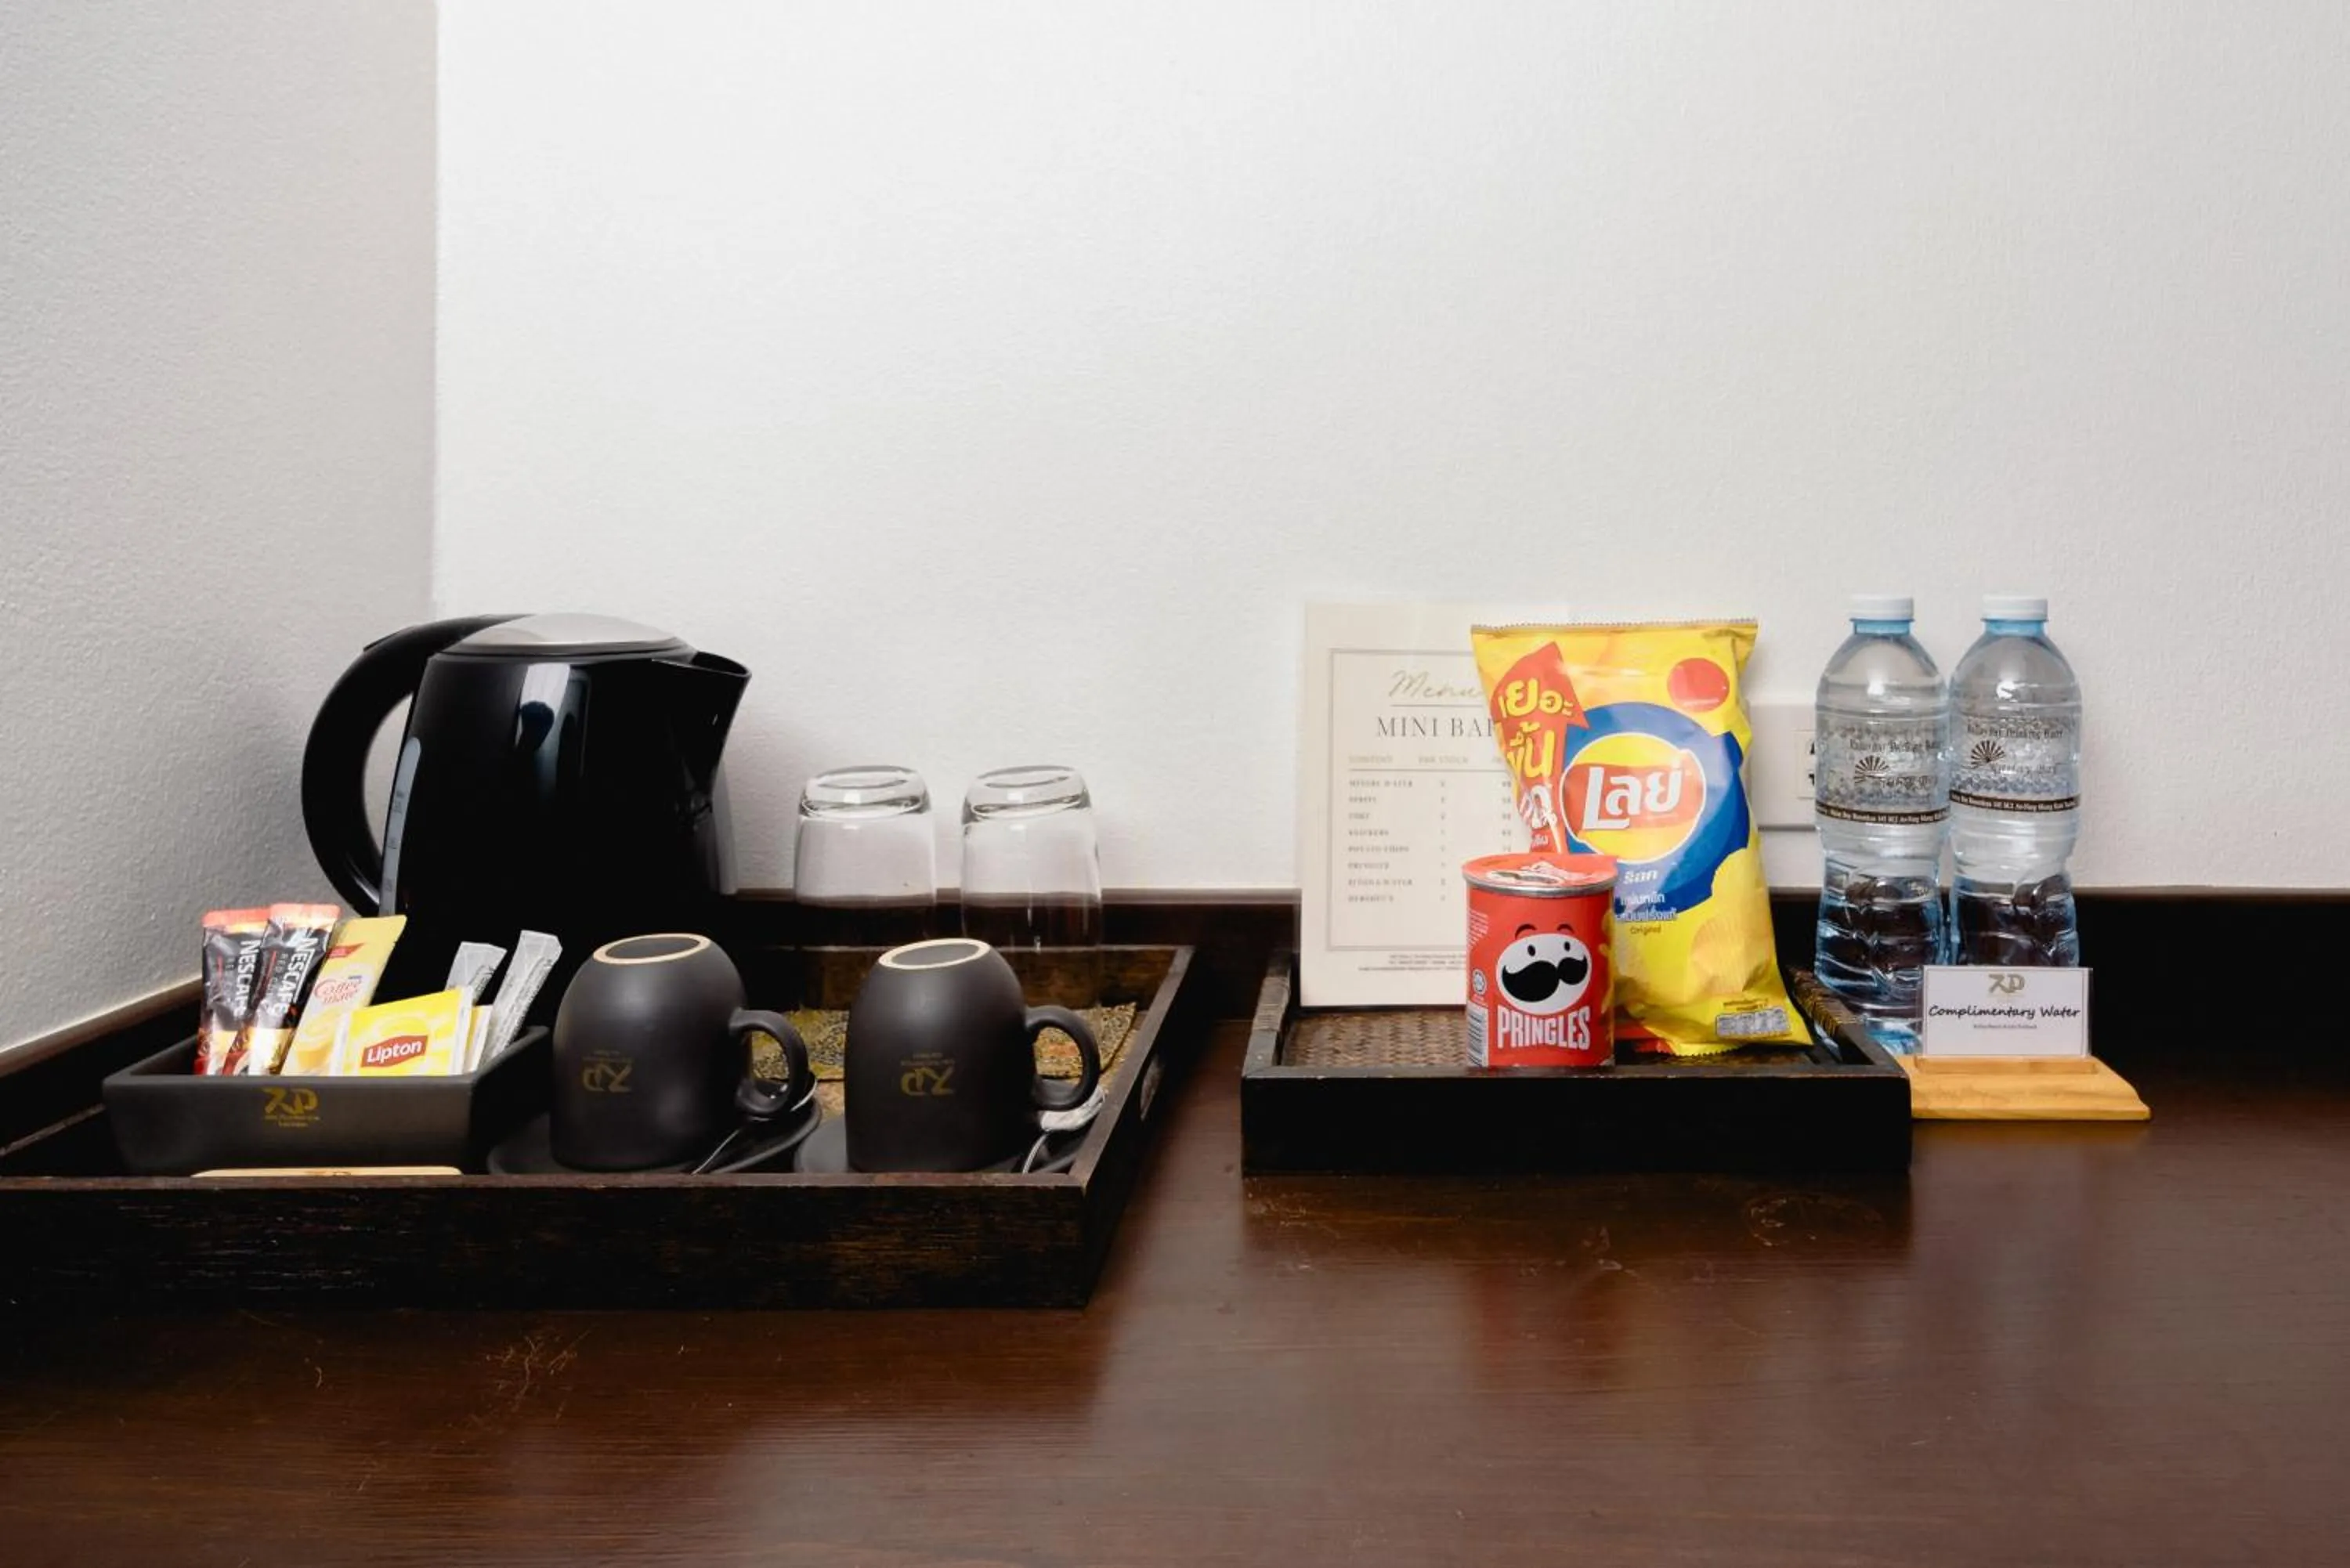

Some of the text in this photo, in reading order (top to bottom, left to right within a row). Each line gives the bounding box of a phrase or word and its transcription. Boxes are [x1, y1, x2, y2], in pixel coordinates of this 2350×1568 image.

[1498, 677, 1574, 718] เยอะ
[1377, 717, 1437, 737] MINI
[1929, 1004, 2081, 1021] Complimentary Water
[1496, 1004, 1590, 1051] PRINGLES
[366, 1040, 423, 1064] Lipton
